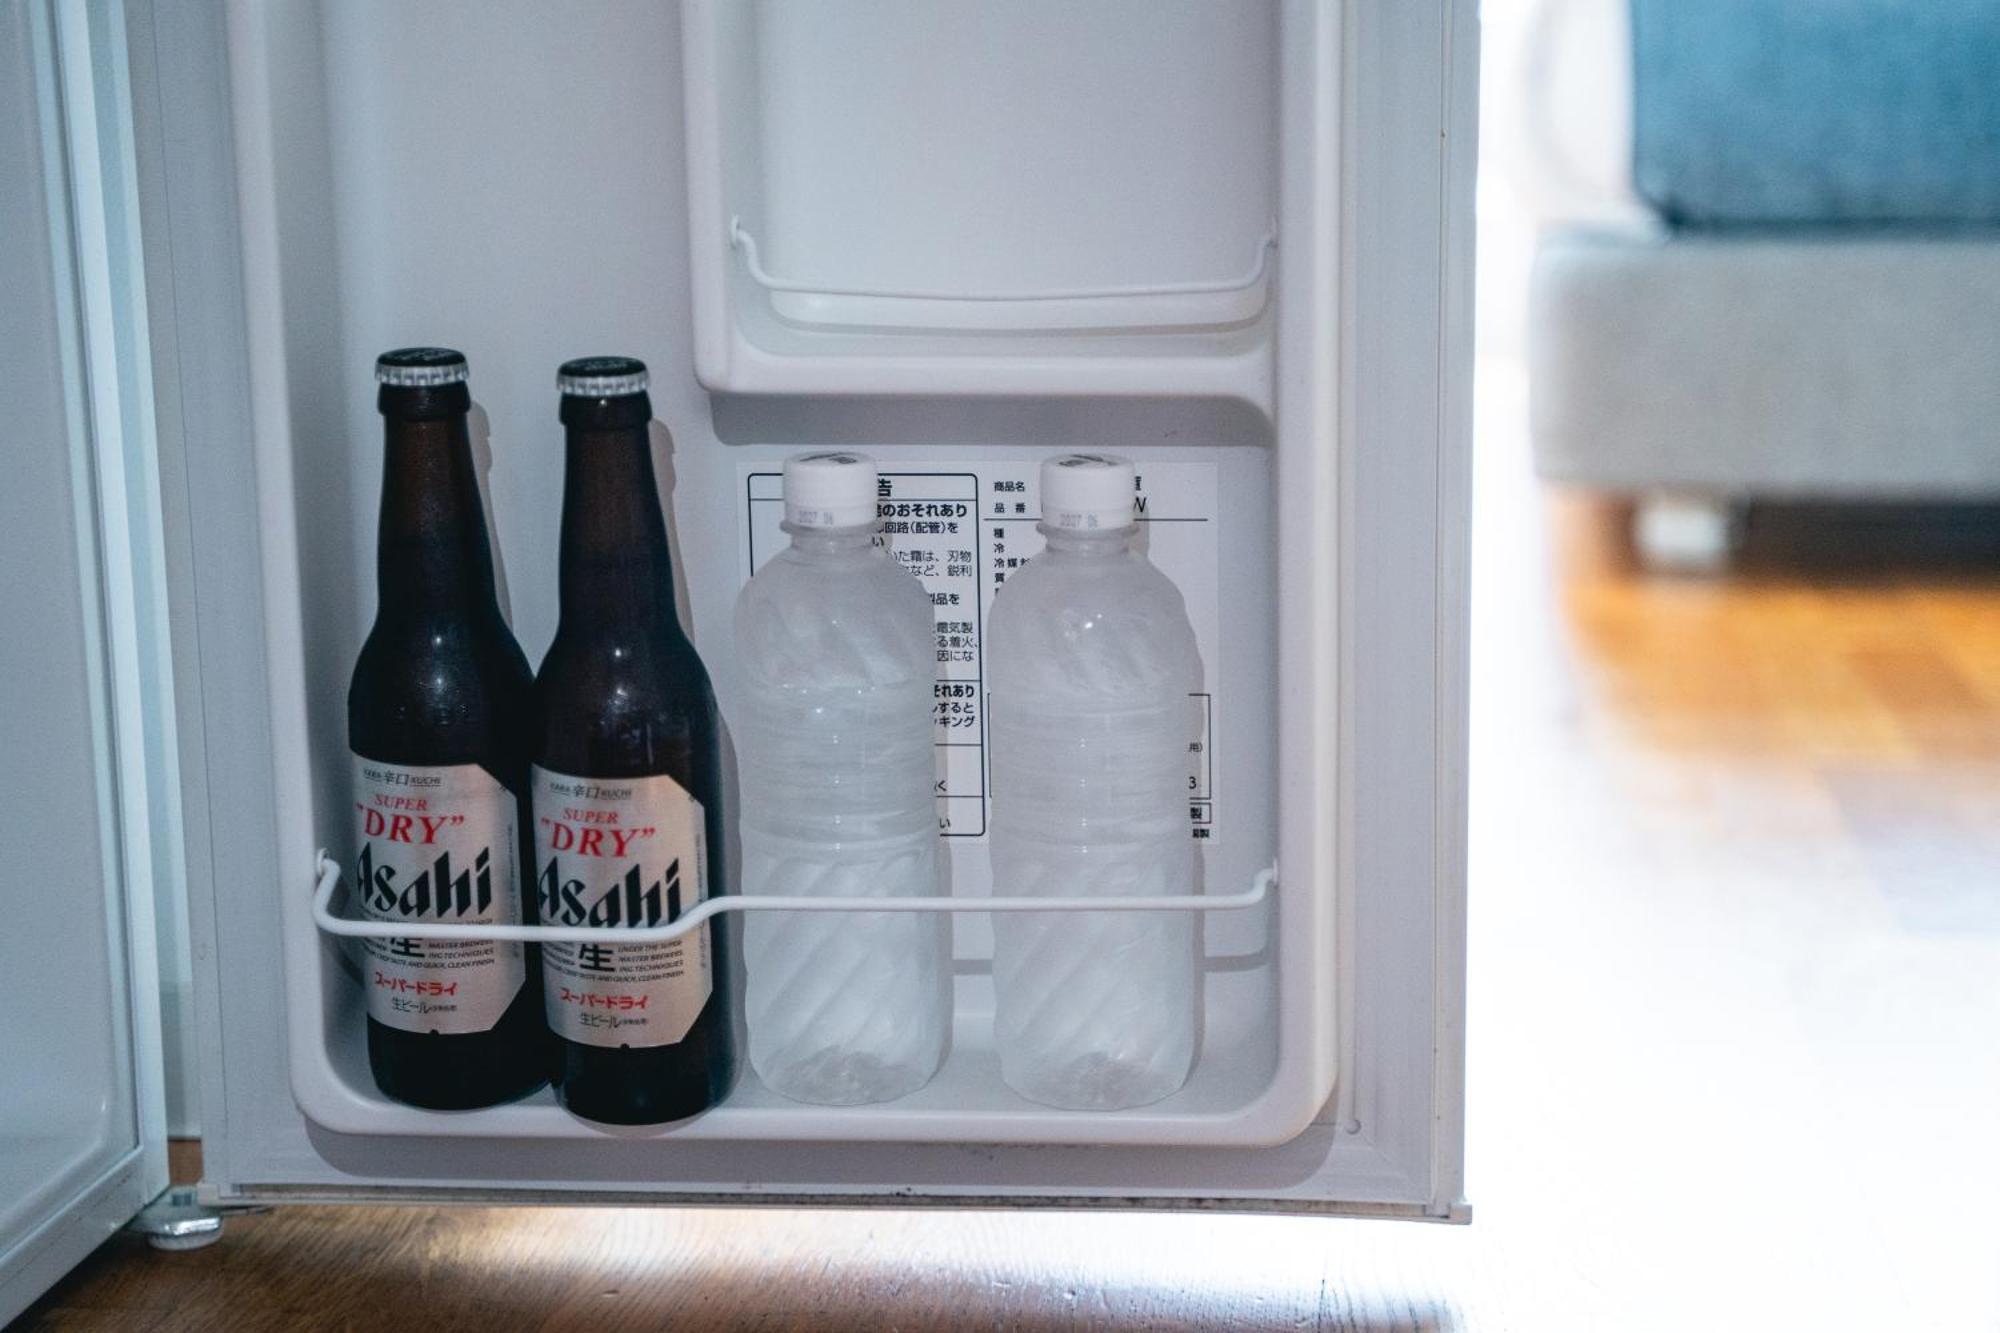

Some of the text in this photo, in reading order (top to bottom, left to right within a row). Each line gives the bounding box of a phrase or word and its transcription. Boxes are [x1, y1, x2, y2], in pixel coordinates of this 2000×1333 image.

[994, 480, 1026, 493] 商品名
[902, 564, 973, 577] など、鋭利
[935, 715, 976, 728] キング
[374, 793, 428, 812] SUPER
[563, 806, 619, 825] SUPER
[356, 841, 493, 918] Asahi
[538, 855, 682, 928] Asahi
[579, 943, 616, 973] 生
[374, 970, 458, 996] スーパードライ
[559, 986, 649, 1010] スーパードライ
